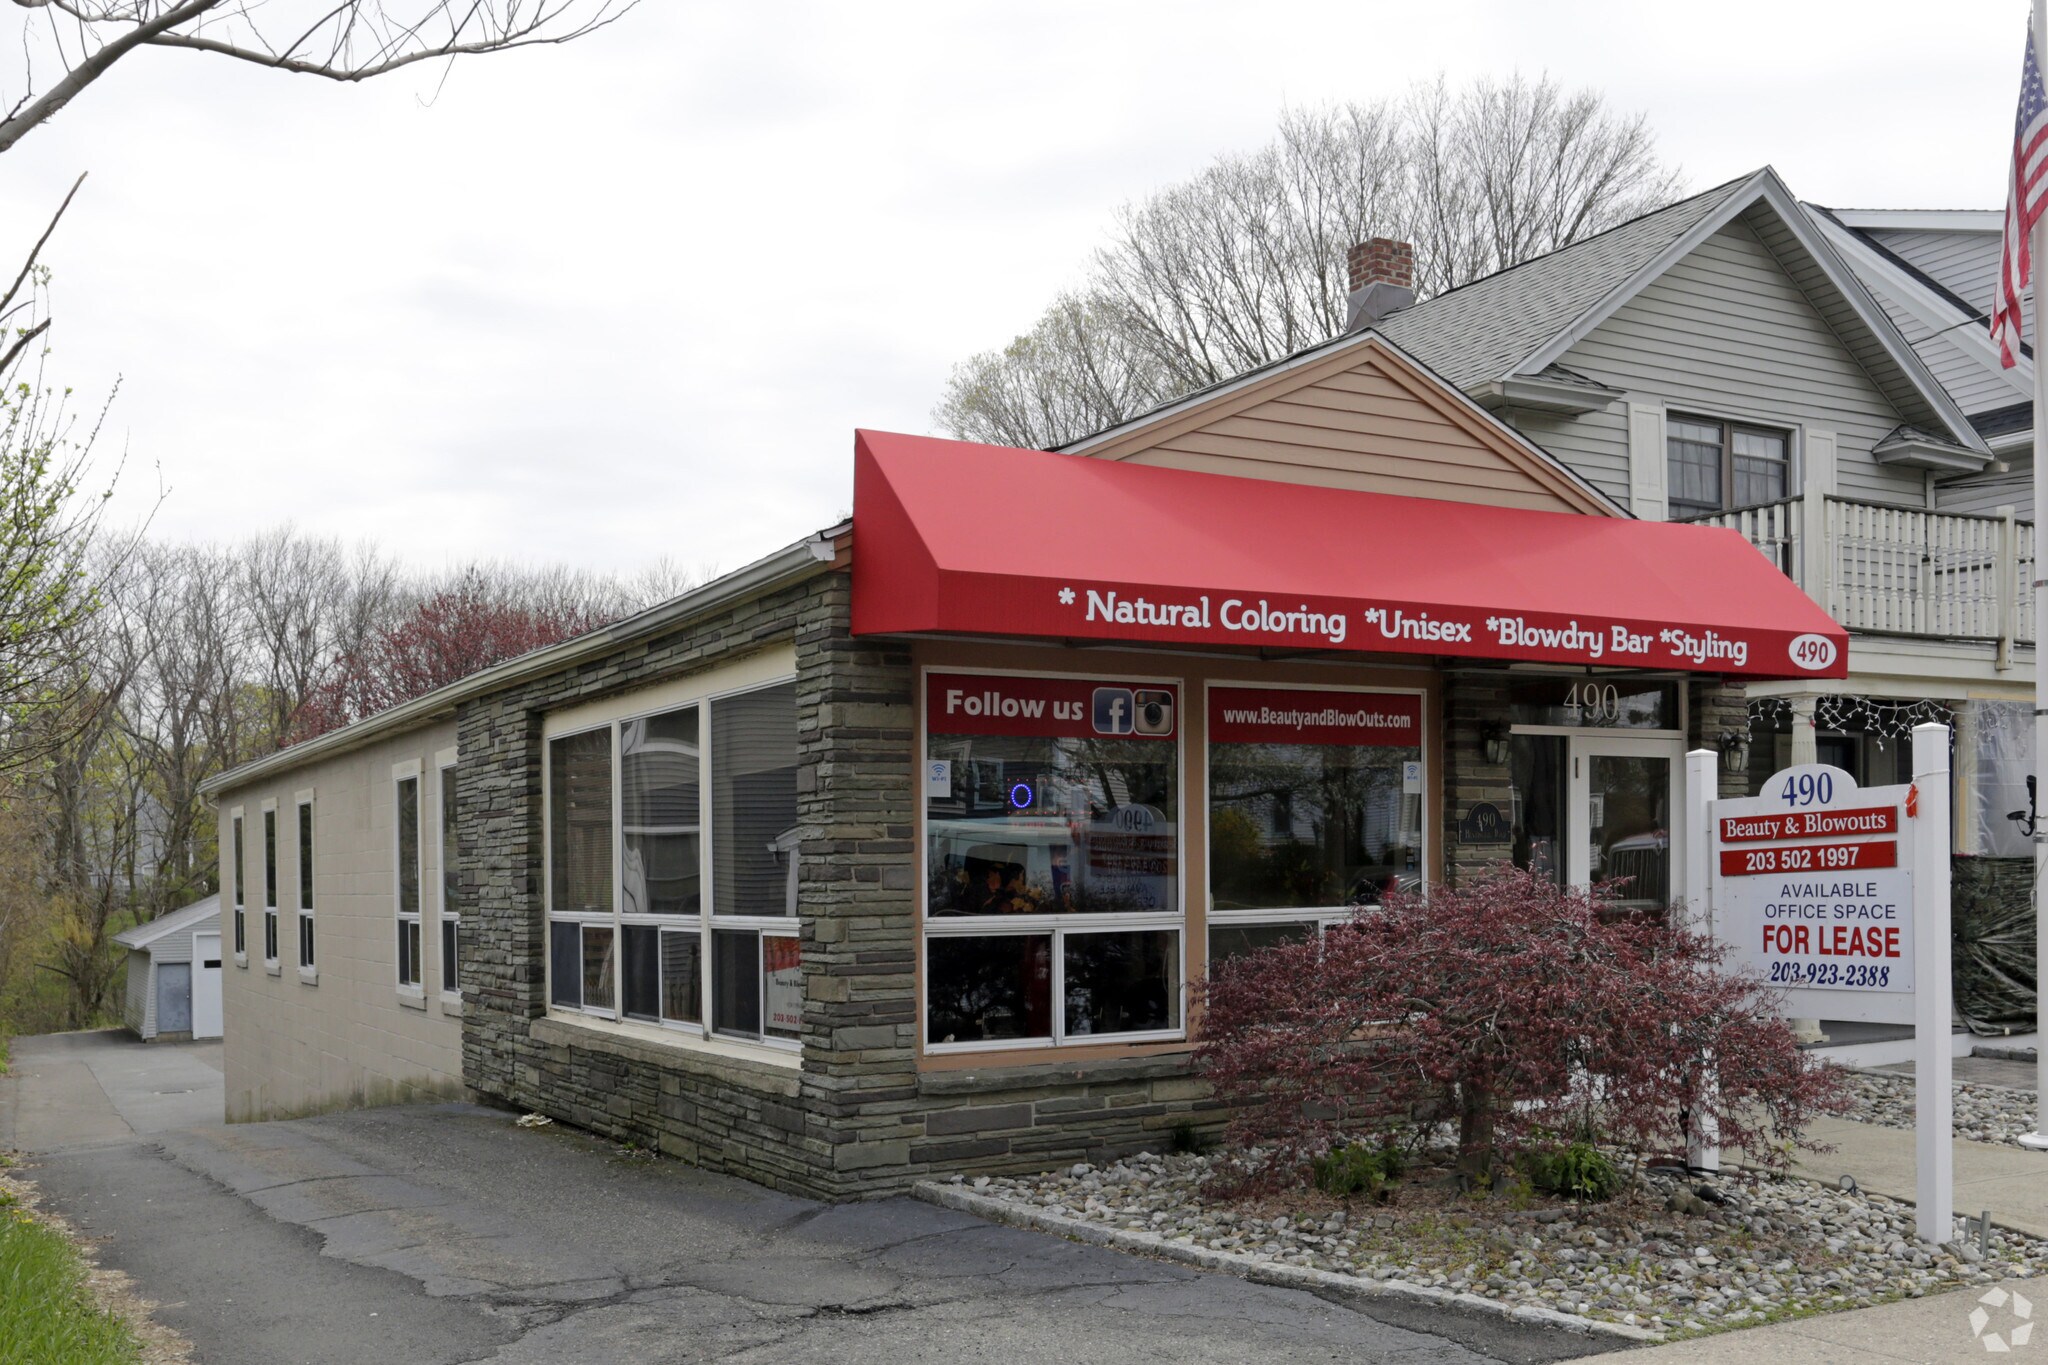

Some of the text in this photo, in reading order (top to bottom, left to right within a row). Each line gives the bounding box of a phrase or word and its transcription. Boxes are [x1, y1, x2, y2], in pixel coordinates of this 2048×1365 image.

[1086, 589, 1211, 629] Natural
[1220, 599, 1346, 643] Coloring
[1611, 625, 1654, 654] Bar
[1797, 639, 1829, 665] 490
[946, 689, 1084, 720] Follow us
[1563, 682, 1620, 721] 490
[1223, 707, 1411, 731] www.BeautyandBlowOuts.com
[1782, 772, 1833, 807] 490
[1725, 812, 1887, 839] Beauty & Blowouts
[1746, 847, 1860, 871] 203 502 1997
[1780, 882, 1878, 898] AVAILABLE
[1765, 904, 1896, 920] OFFICE SPACE
[1763, 924, 1901, 958] FOR LEASE
[1770, 961, 1891, 988] 203-923-2388
